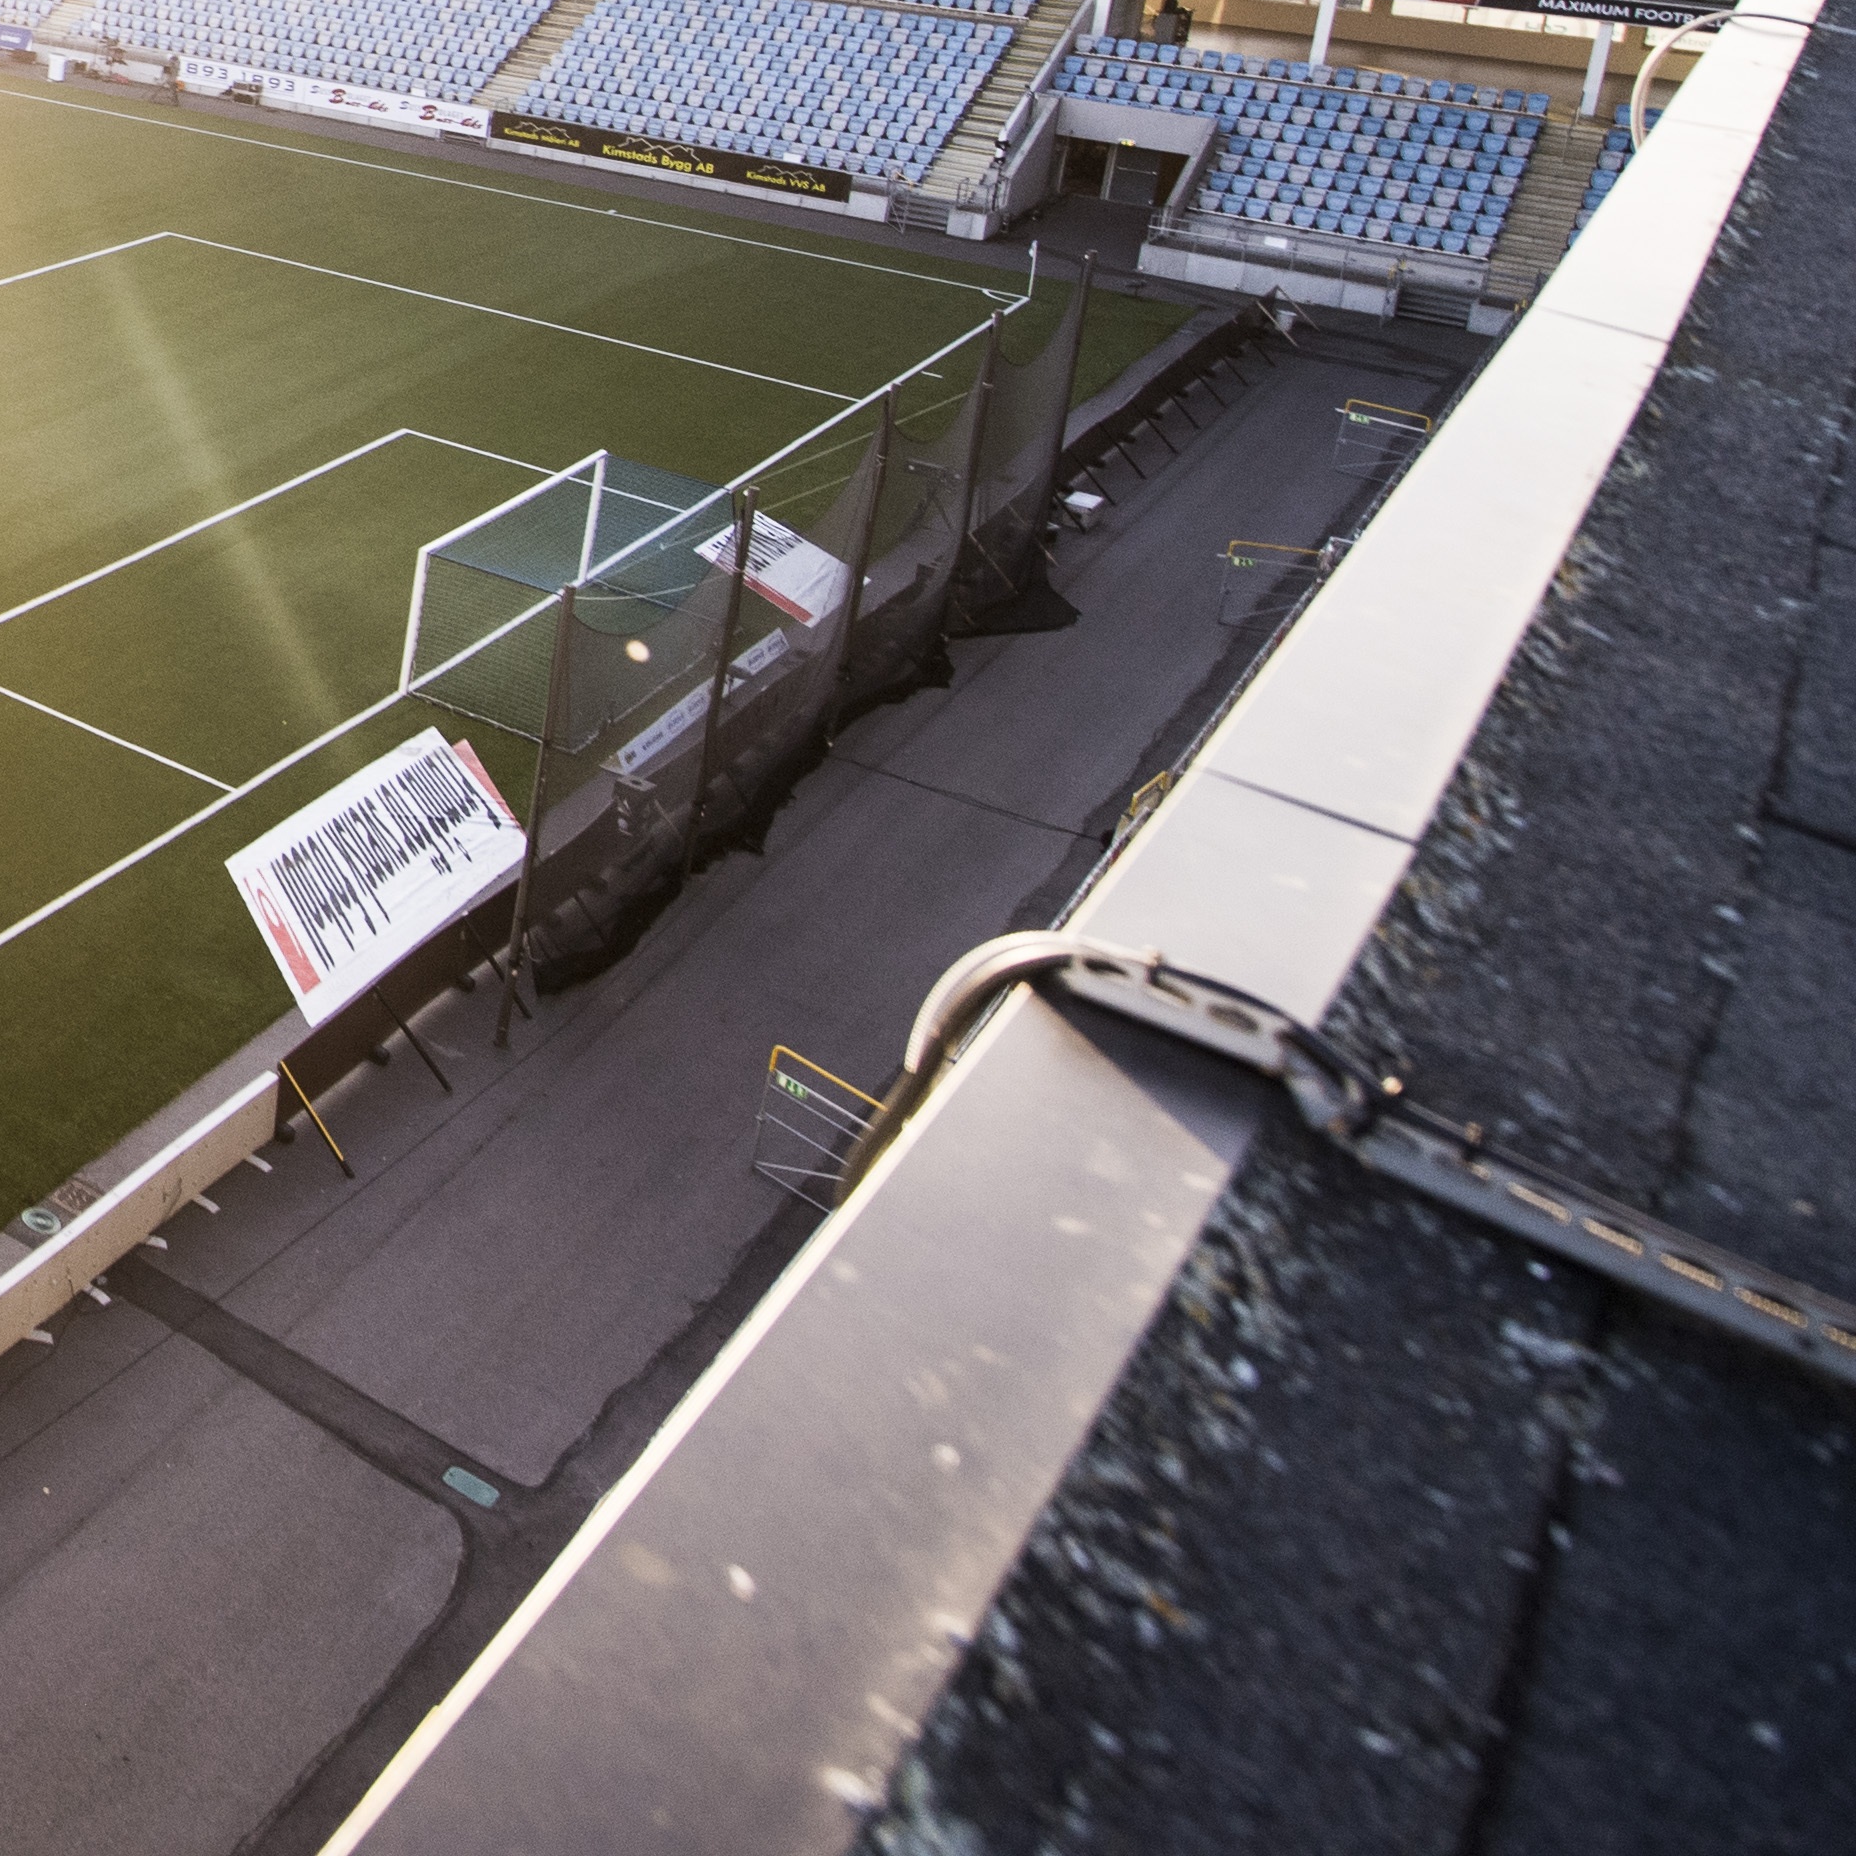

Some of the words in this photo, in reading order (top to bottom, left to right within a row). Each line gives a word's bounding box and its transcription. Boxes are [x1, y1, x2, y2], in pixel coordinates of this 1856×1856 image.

[602, 144, 658, 165] Kimstads
[661, 155, 692, 174] Bygg
[695, 161, 715, 174] AB
[746, 170, 786, 186] Kimstads
[789, 177, 809, 190] VVS
[811, 182, 826, 193] AB
